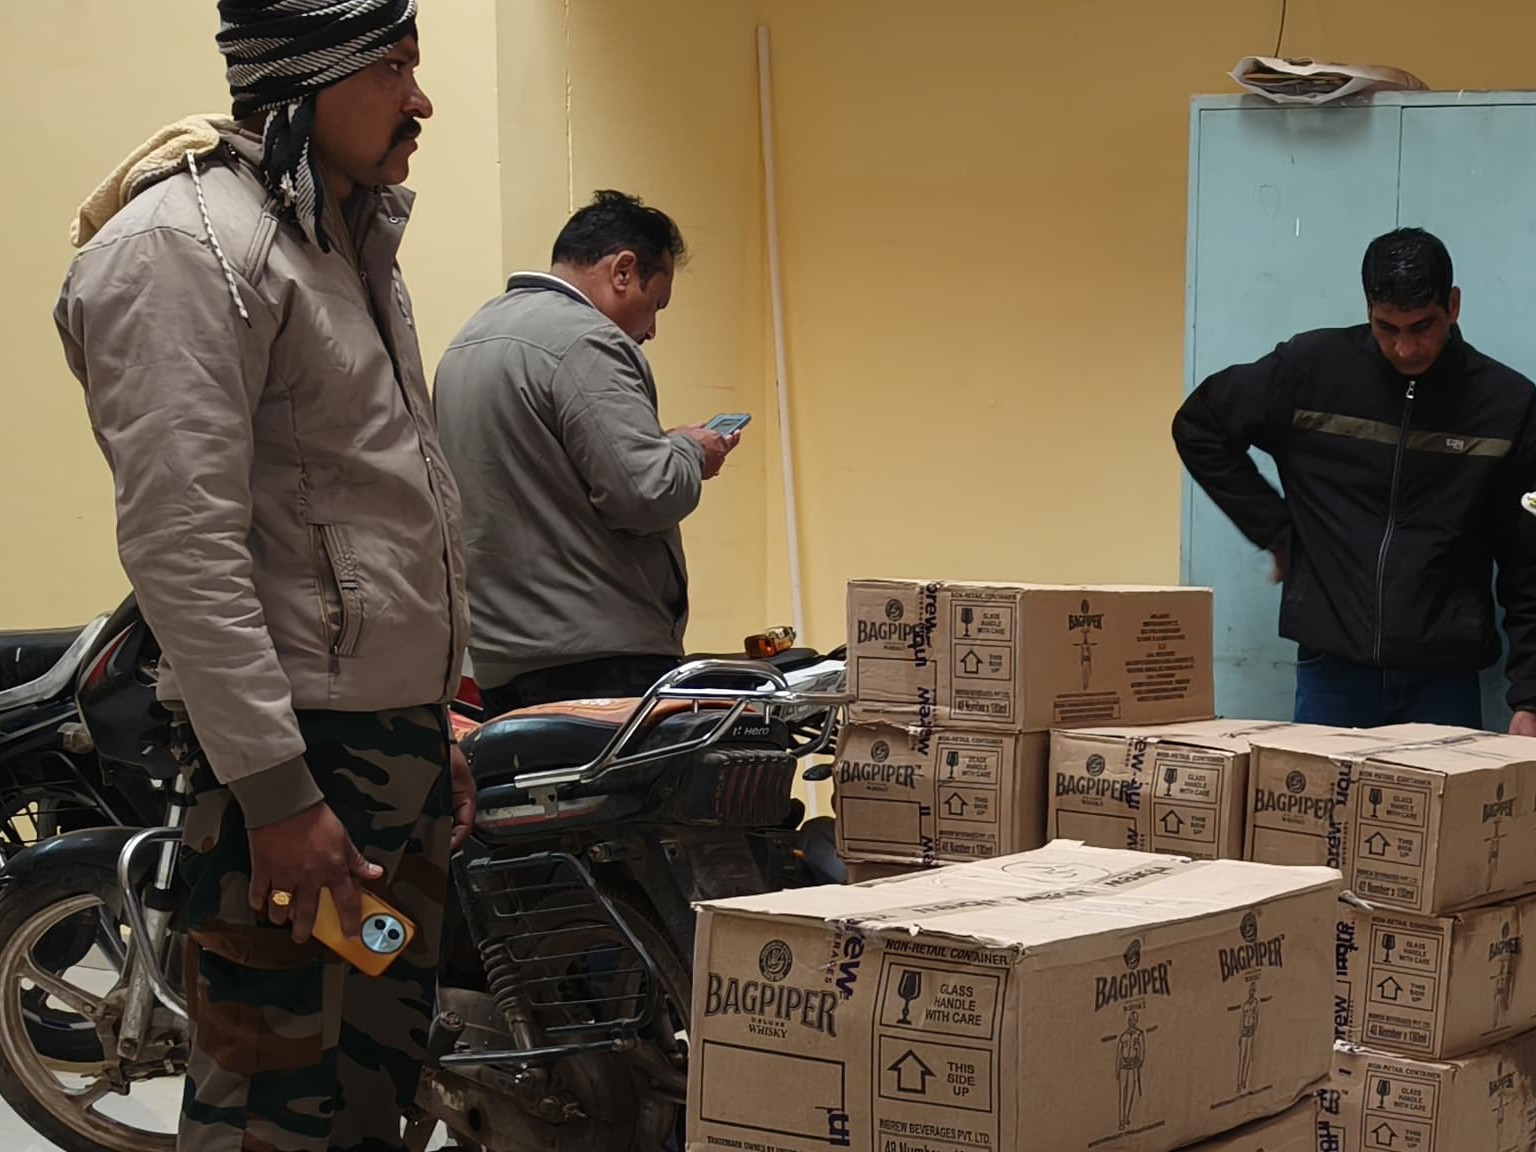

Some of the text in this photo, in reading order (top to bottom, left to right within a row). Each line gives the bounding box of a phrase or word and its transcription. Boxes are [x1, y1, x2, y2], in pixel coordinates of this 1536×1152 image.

[884, 938, 1010, 965] NON-RETAIL CONTAINER
[1218, 937, 1283, 983] BAGPIPER
[940, 983, 973, 997] GLASS
[1094, 962, 1172, 1012] BAGPIPER
[704, 972, 838, 1037] BAGPIPER
[934, 996, 976, 1012] HANDLE
[925, 1007, 982, 1026] WITH CARE
[749, 1023, 788, 1039] WHISKY
[947, 1061, 974, 1074] THIS
[947, 1070, 975, 1086] SIDE
[953, 1085, 969, 1096] UP
